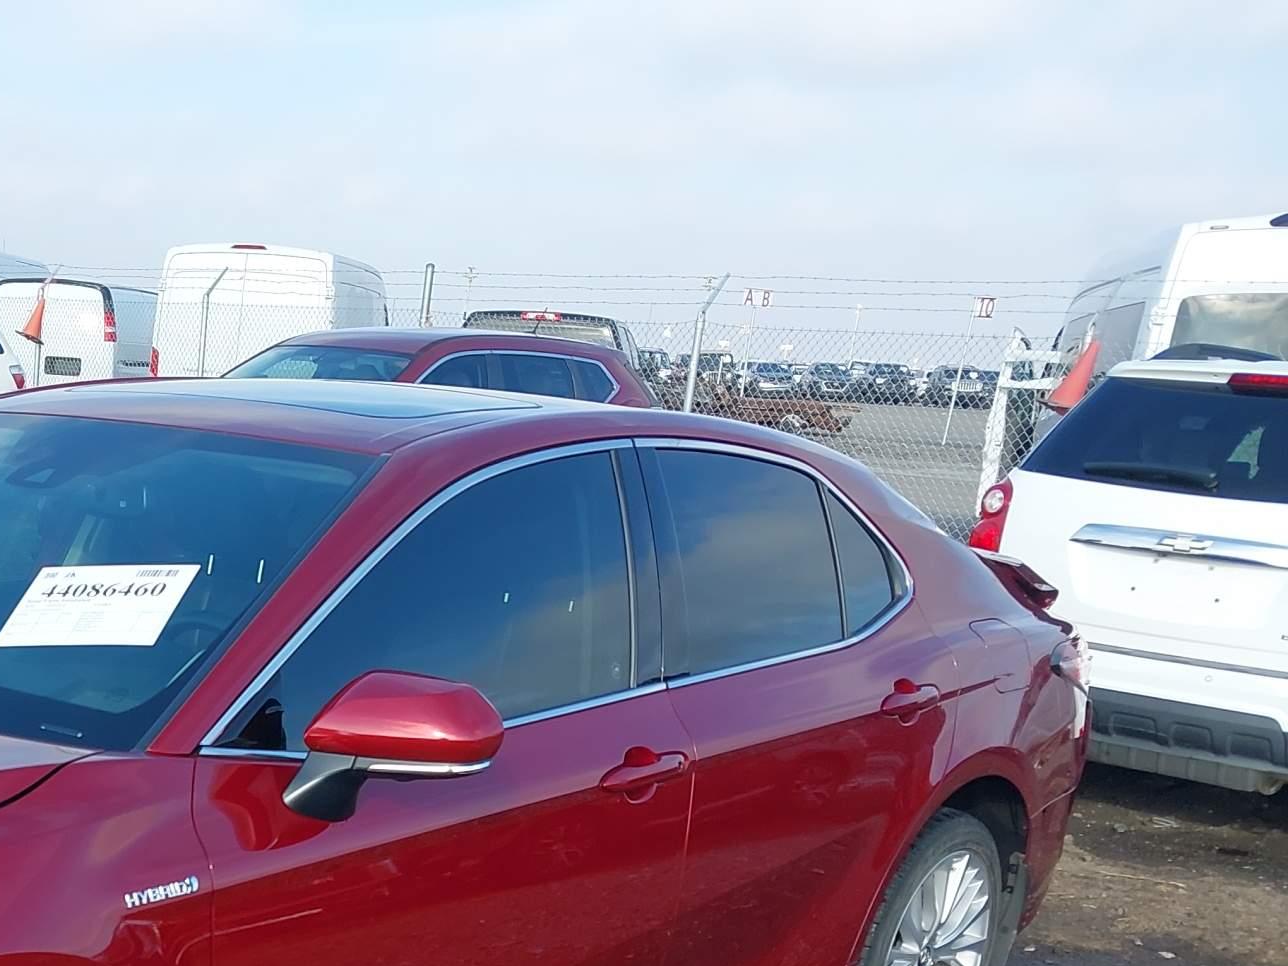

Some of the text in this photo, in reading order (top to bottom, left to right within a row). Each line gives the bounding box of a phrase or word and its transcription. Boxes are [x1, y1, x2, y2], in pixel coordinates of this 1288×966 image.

[744, 289, 770, 308] A B
[41, 582, 167, 598] 44086460
[124, 879, 189, 908] HYBRID
